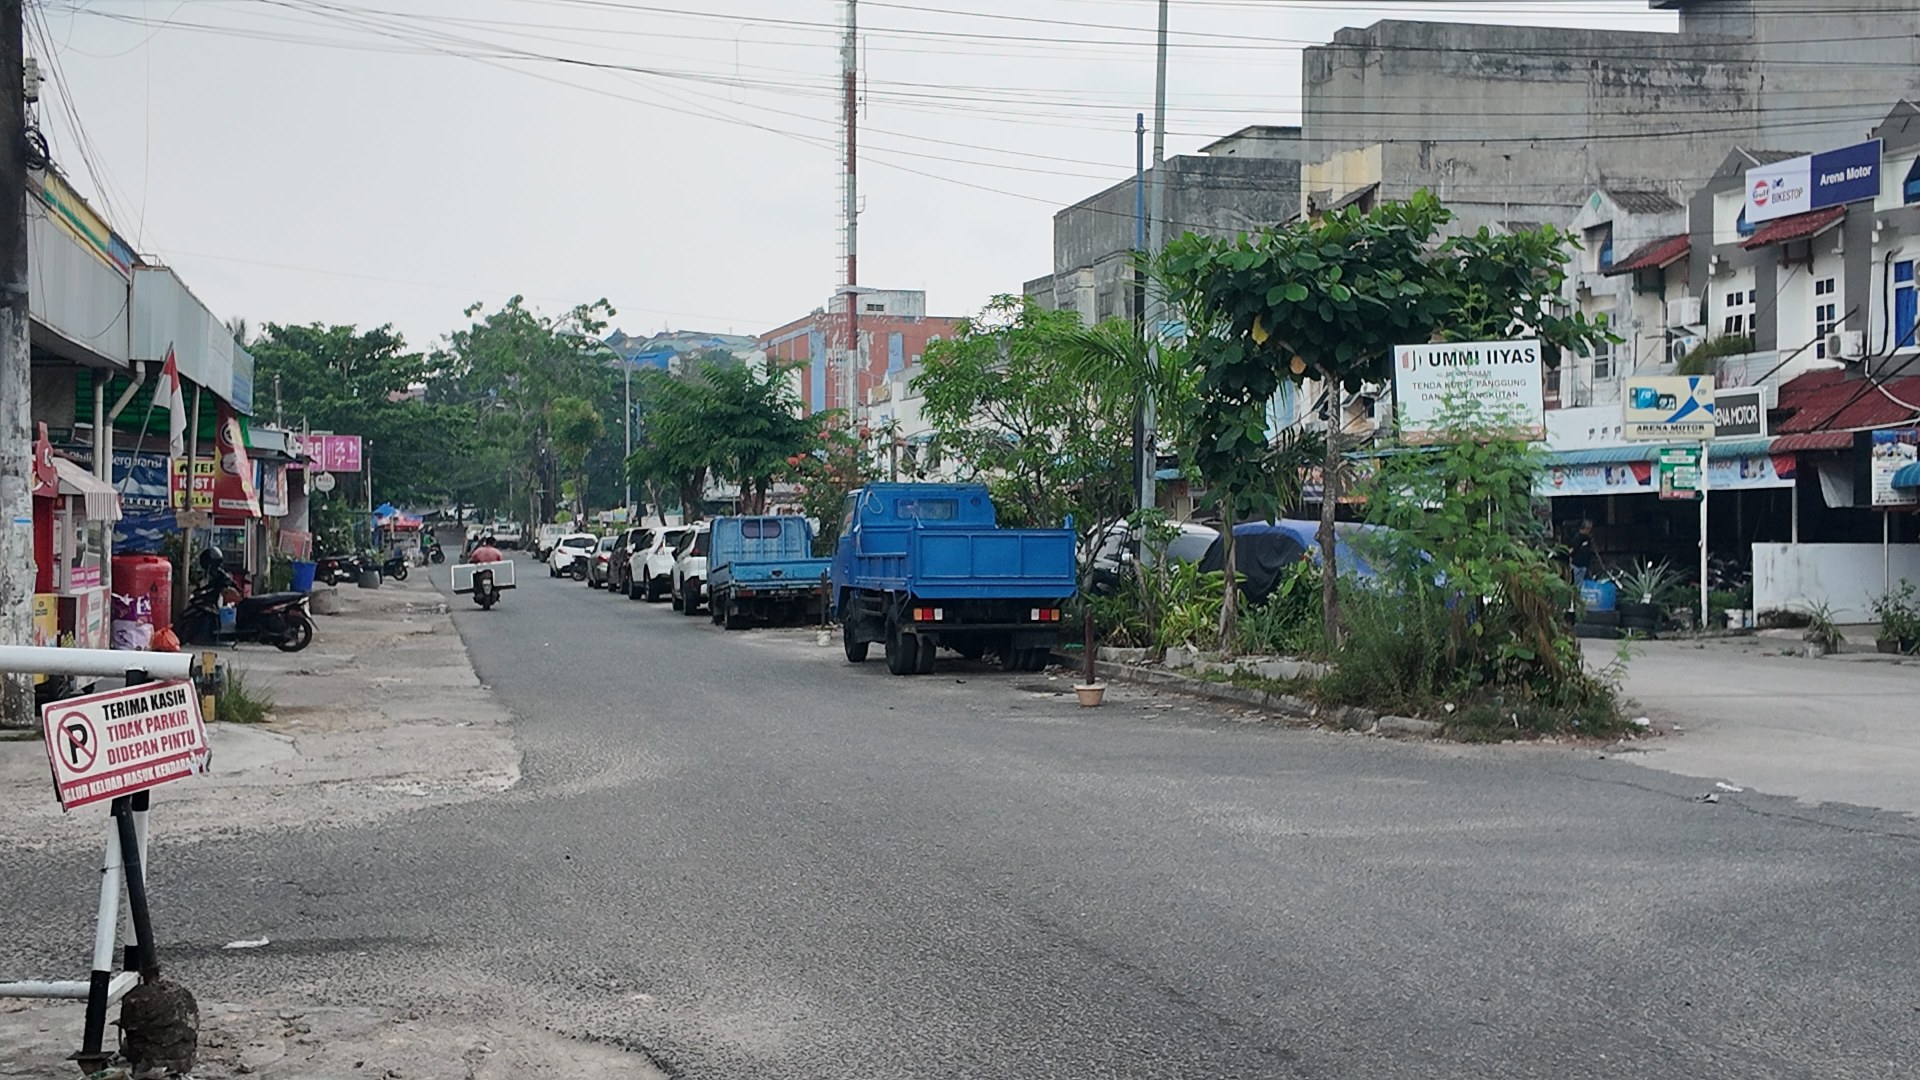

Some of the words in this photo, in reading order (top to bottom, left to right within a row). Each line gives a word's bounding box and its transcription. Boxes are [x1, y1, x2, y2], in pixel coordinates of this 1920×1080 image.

[1820, 172, 1845, 186] Arena
[1846, 165, 1872, 181] Motor
[1771, 187, 1803, 204] BIKESTOP
[1412, 382, 1442, 391] TENDA
[1476, 379, 1527, 388] PANGGUNG
[1470, 391, 1519, 400] ANGKUTAN
[1731, 404, 1758, 425] MOTOR
[1637, 424, 1668, 432] ARENA
[1670, 424, 1705, 432] MOTOR
[102, 697, 149, 721] TERIMA
[151, 689, 187, 711] KASIH
[106, 719, 144, 742] TIDAK
[147, 710, 189, 733] PARKIR
[107, 738, 159, 765] DIDEPAN
[161, 729, 196, 748] PINTU
[90, 776, 124, 795] KELUAR
[124, 769, 156, 787] MASUK
